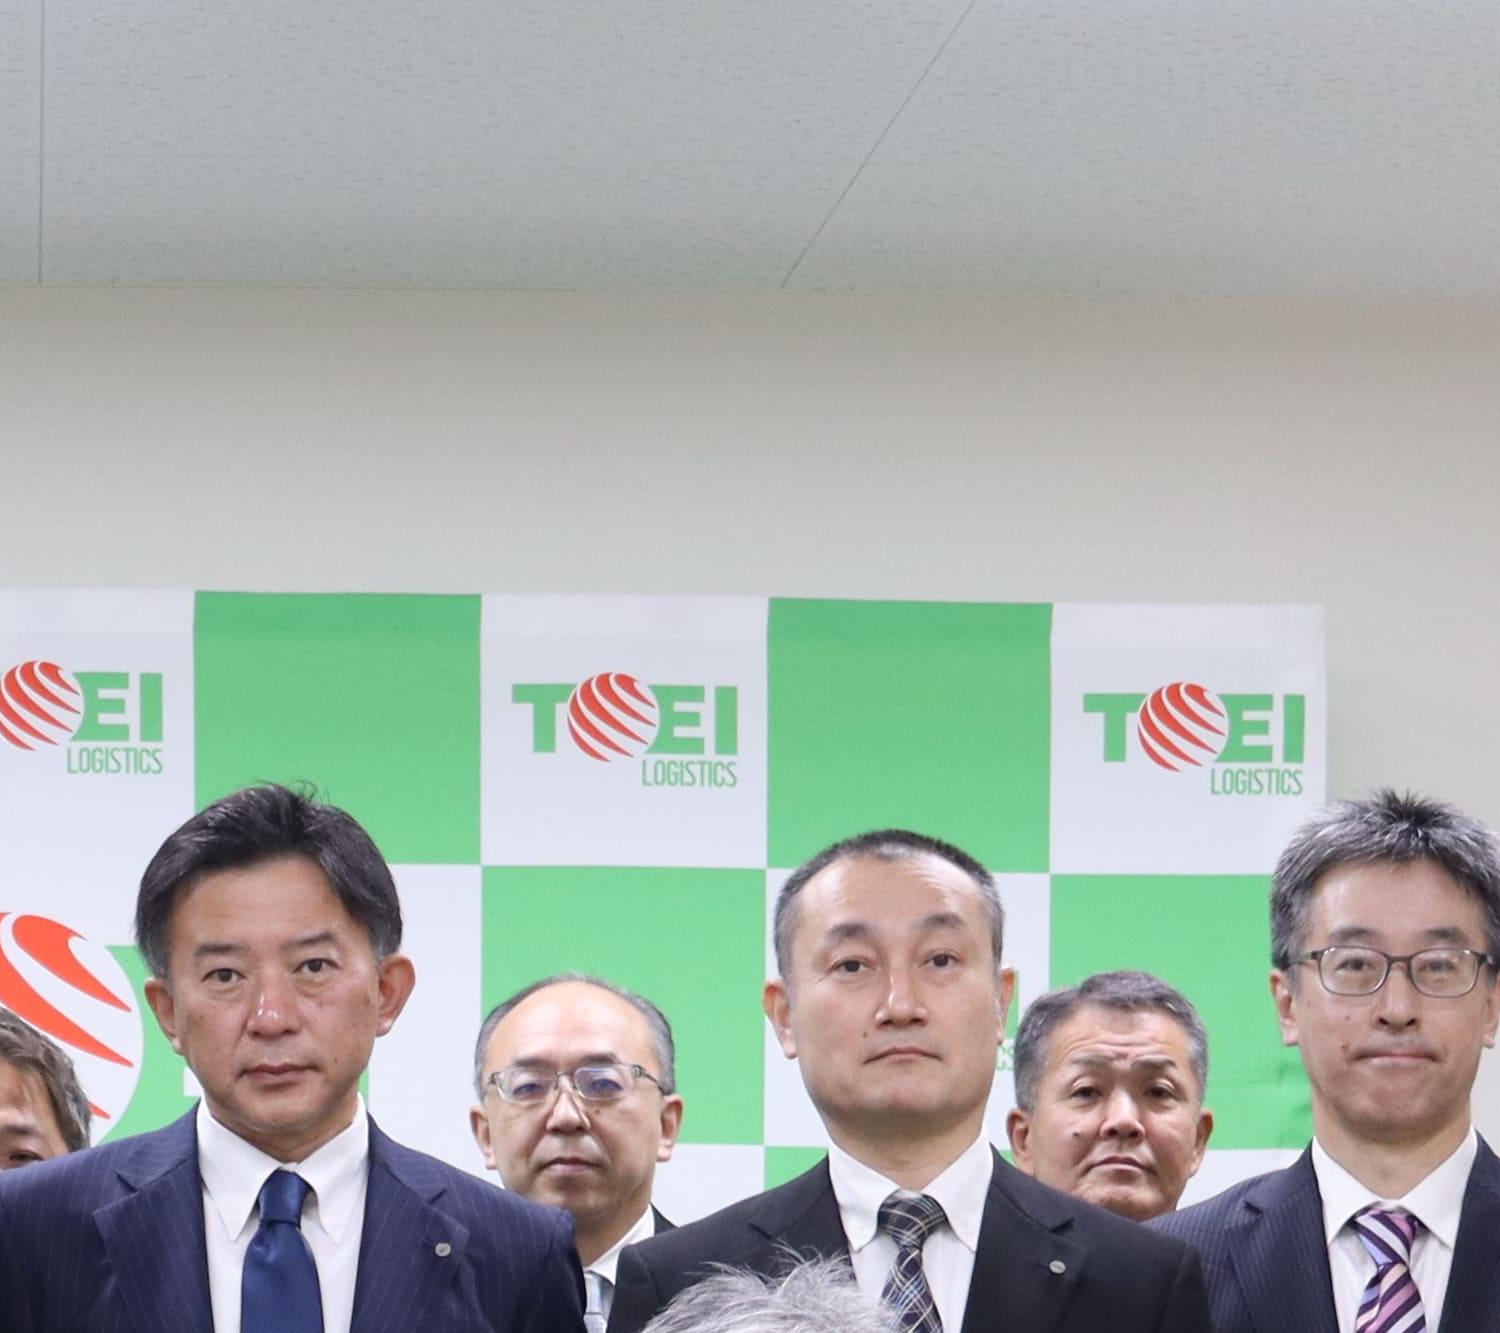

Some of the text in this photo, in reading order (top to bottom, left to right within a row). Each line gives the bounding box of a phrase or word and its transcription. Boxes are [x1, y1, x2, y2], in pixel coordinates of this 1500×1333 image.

[513, 672, 739, 763] TOEI
[1083, 682, 1305, 772] TOEI
[67, 747, 164, 774] LOGISTICS
[641, 759, 738, 788] LOGISTICS
[1211, 768, 1304, 796] LOGISTICS
